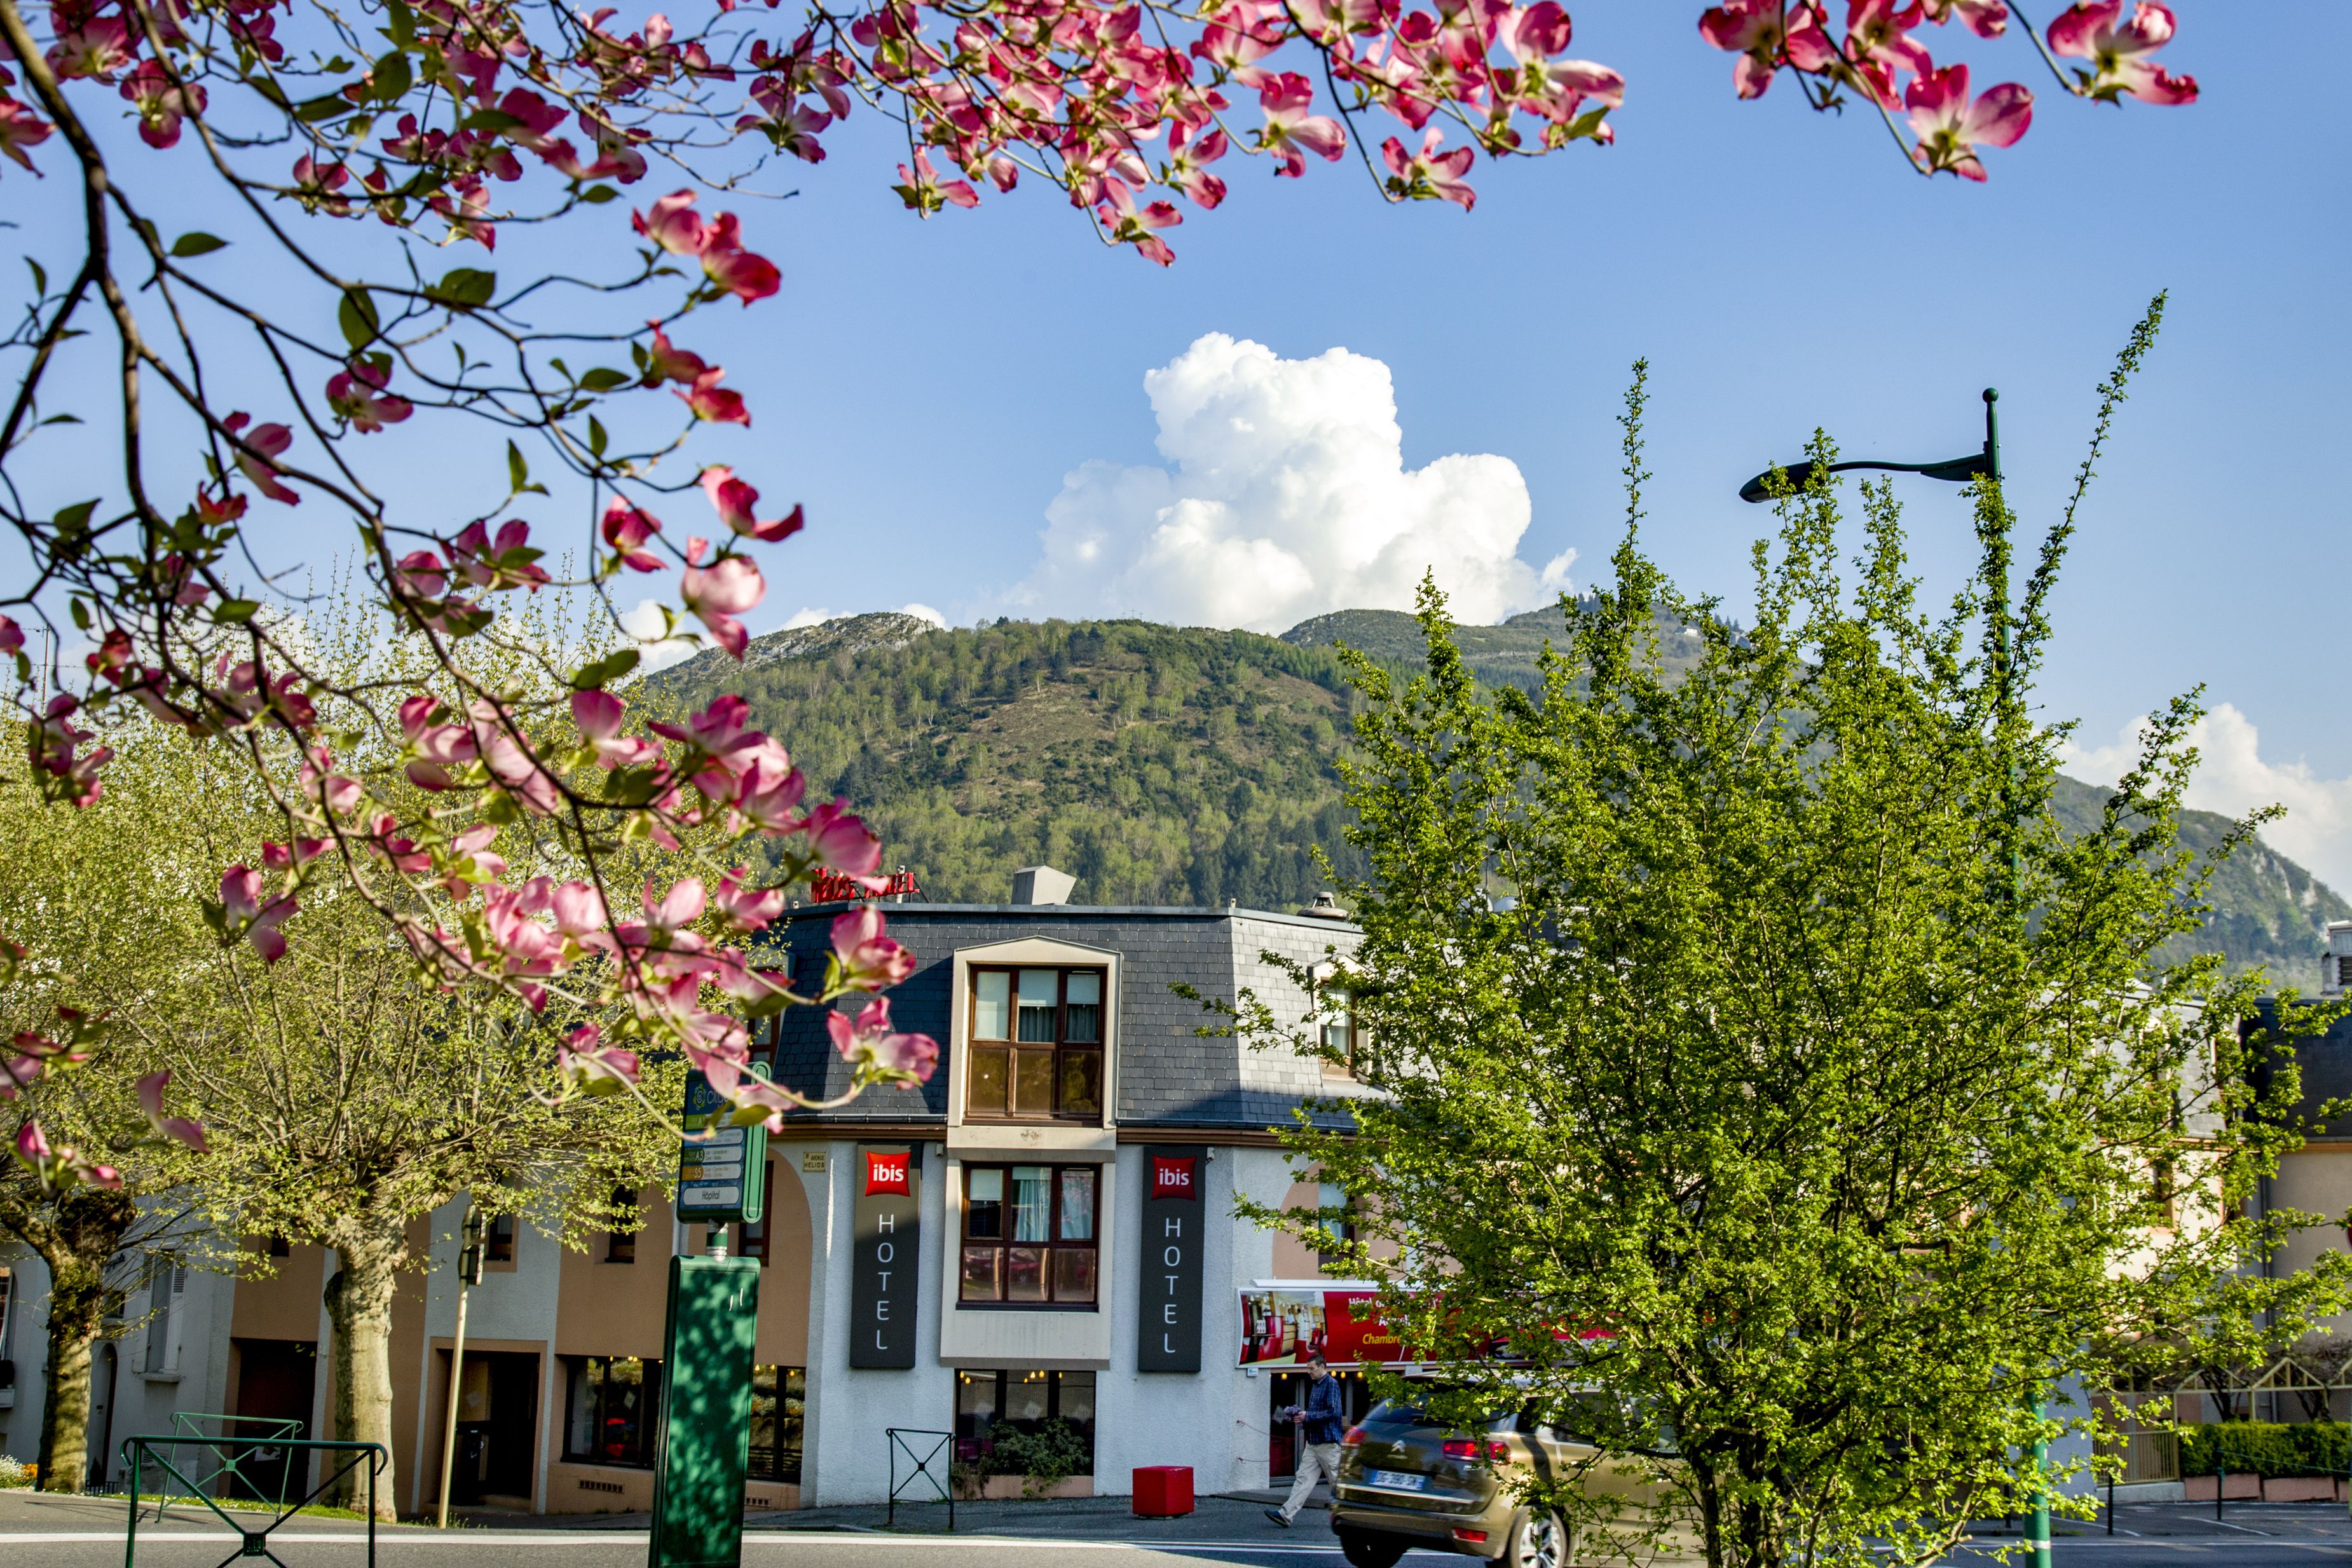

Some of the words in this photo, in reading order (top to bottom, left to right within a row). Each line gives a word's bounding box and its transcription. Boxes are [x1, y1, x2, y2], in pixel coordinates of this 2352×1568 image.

[695, 1150, 704, 1161] A3
[694, 1167, 702, 1178] S5
[873, 1164, 904, 1182] ibis
[1159, 1168, 1189, 1186] ibis
[702, 1190, 720, 1201] Hôpital
[876, 1214, 894, 1350] HOTEL
[1163, 1218, 1181, 1353] HOTEL
